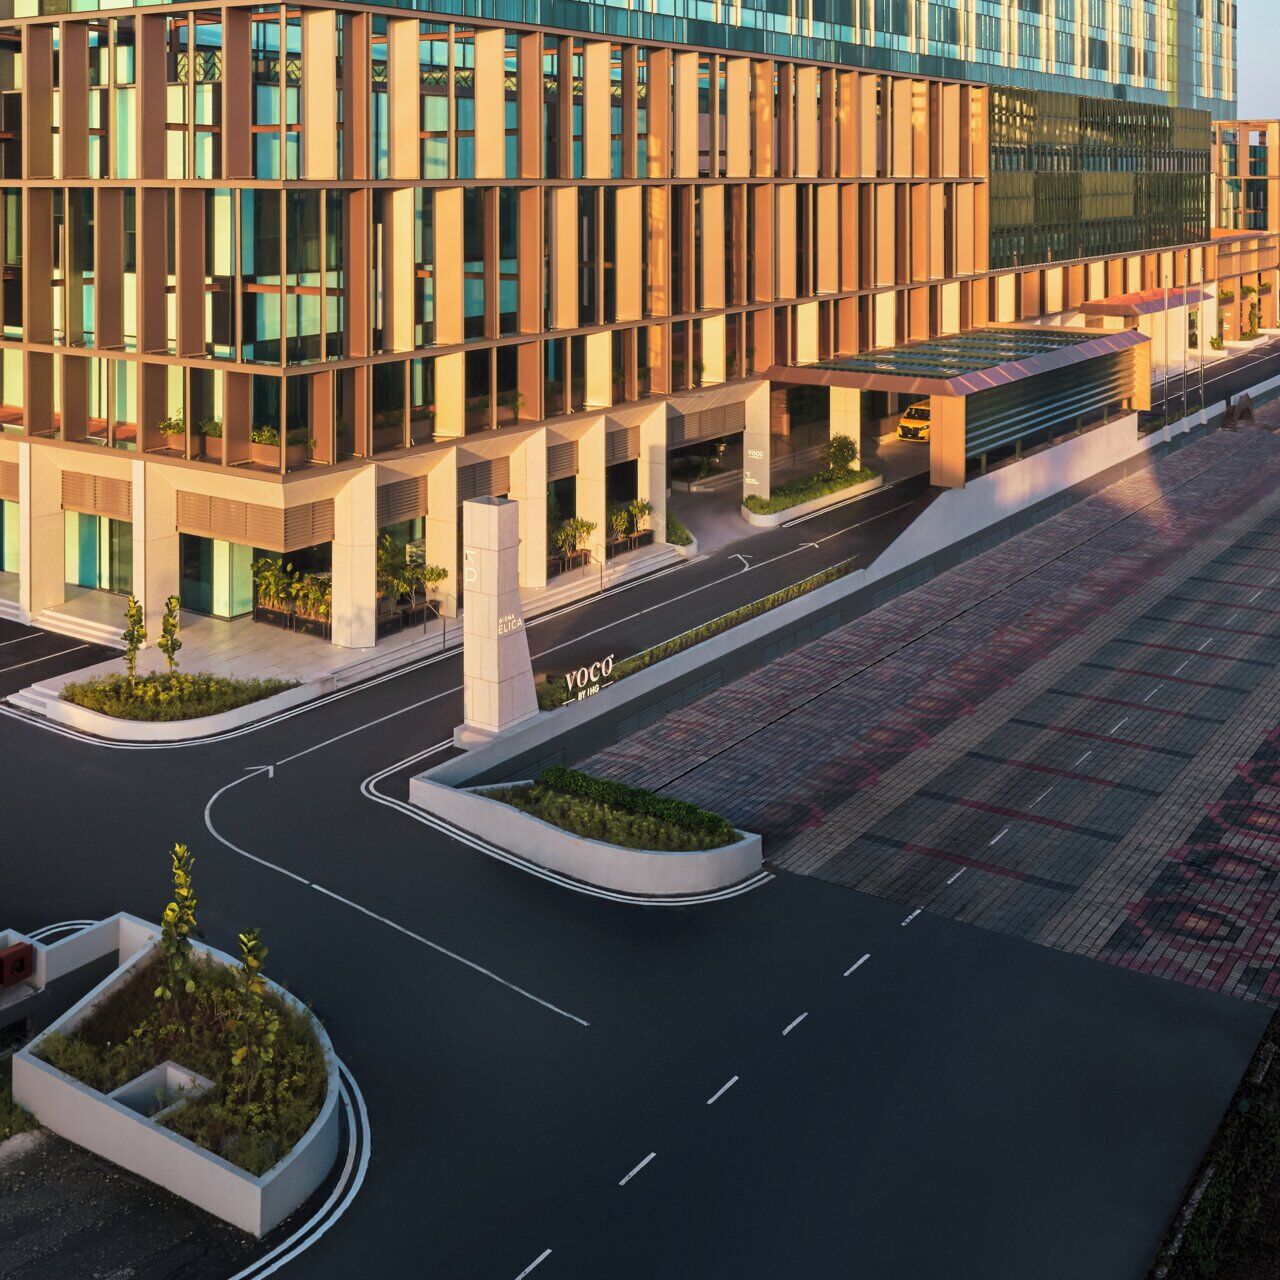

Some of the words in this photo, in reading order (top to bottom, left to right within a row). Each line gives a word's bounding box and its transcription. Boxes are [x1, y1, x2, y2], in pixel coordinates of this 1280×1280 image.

[465, 567, 477, 588] P
[498, 618, 523, 635] ELICA
[578, 690, 587, 701] BY
[587, 684, 600, 697] IHG
